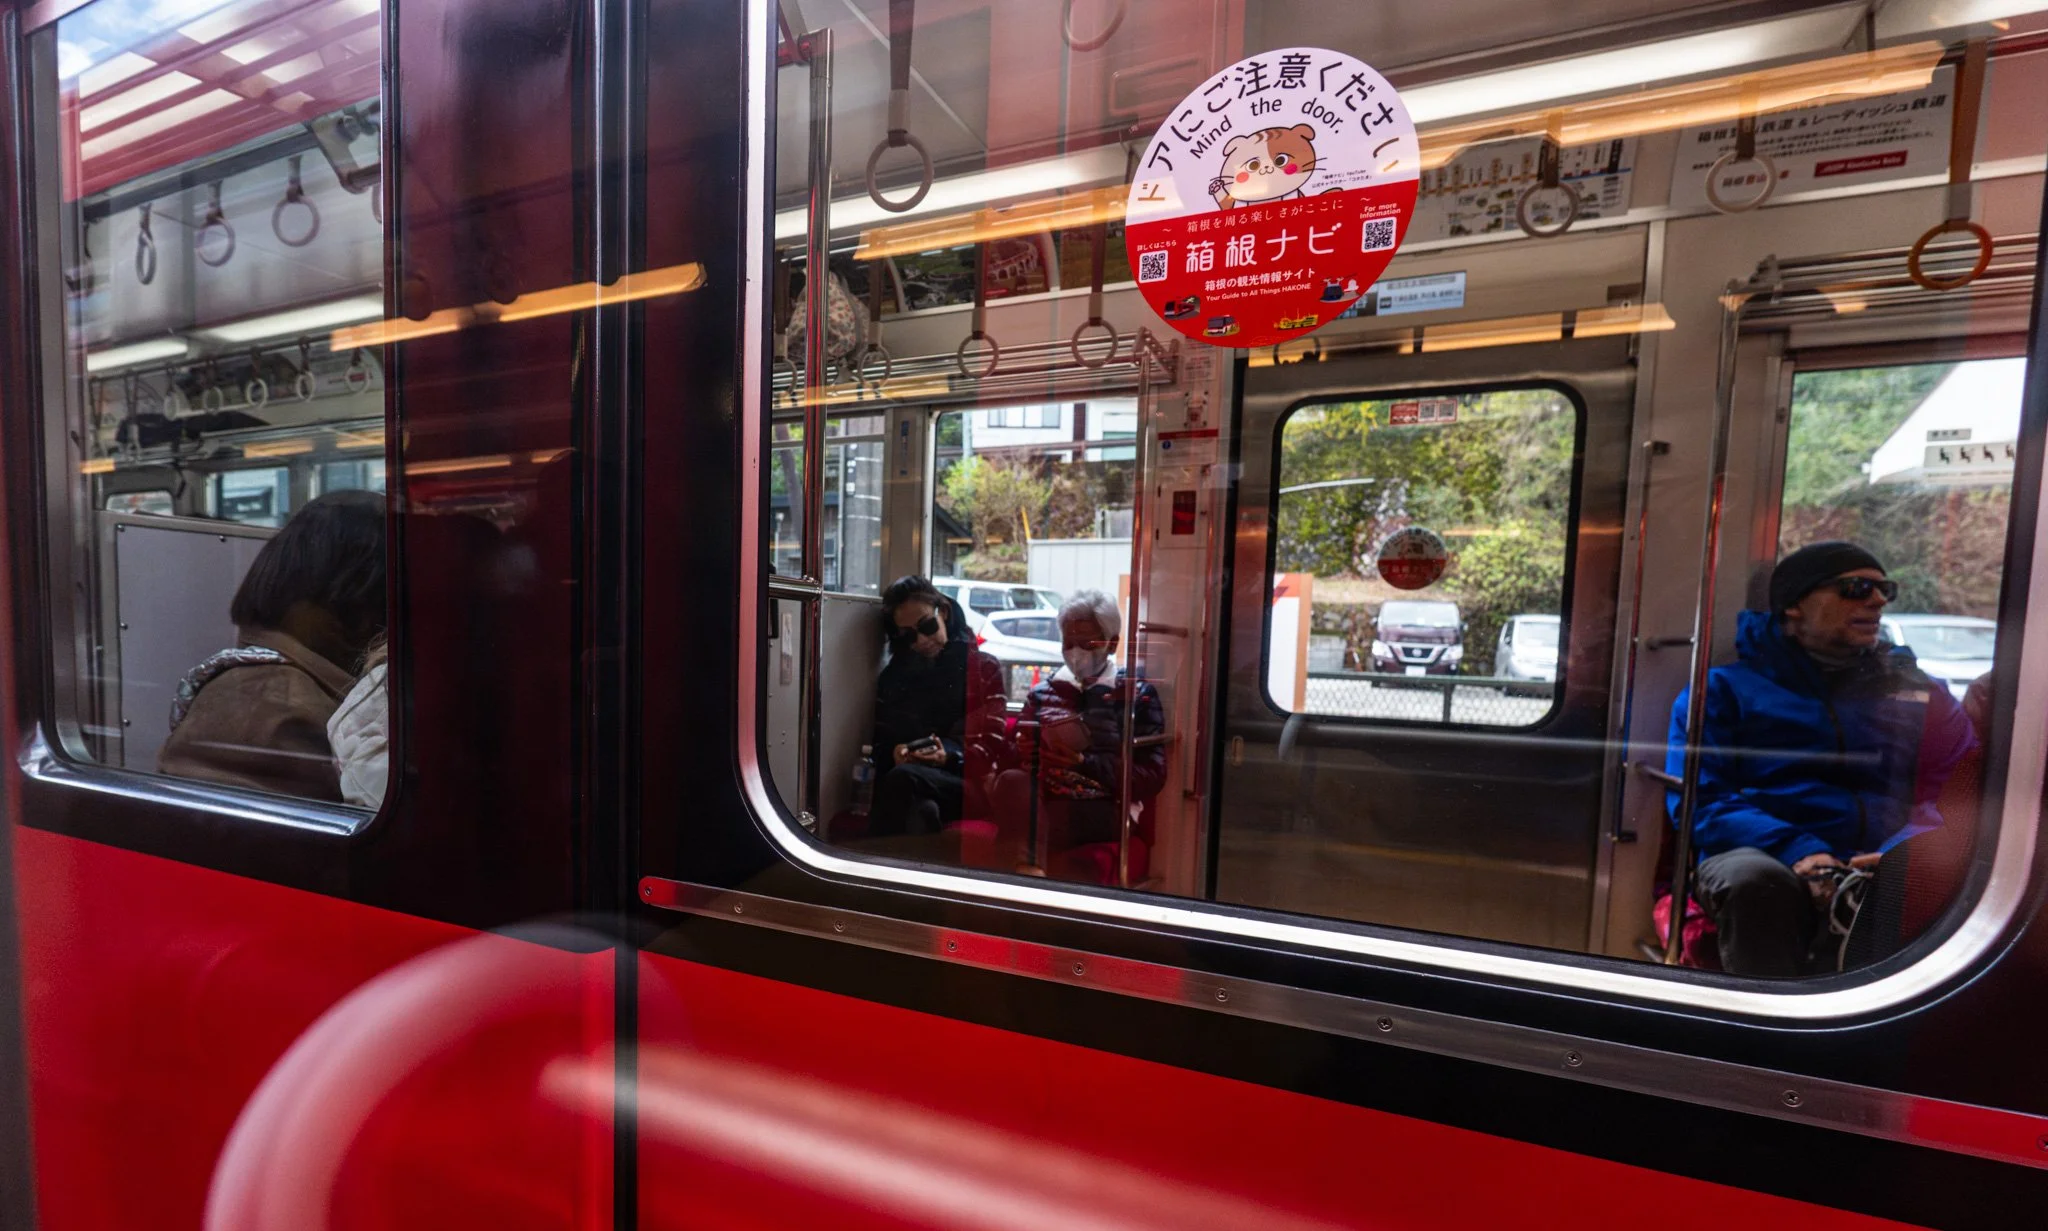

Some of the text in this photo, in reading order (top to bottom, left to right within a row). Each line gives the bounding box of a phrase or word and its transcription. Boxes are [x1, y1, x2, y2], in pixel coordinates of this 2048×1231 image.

[1138, 53, 1399, 201] ドアにご注意ください
[1189, 97, 1344, 159] Mind the door.
[1378, 202, 1397, 211] more
[1137, 240, 1177, 251] 詳しくはこちら
[1186, 222, 1342, 273] 箱根ナビ
[1204, 268, 1315, 291] 箱根の観光情報サイト
[1206, 294, 1221, 302] Your
[1221, 291, 1239, 299] Guide
[1260, 286, 1281, 296] Things
[1282, 283, 1312, 292] HAKONE
